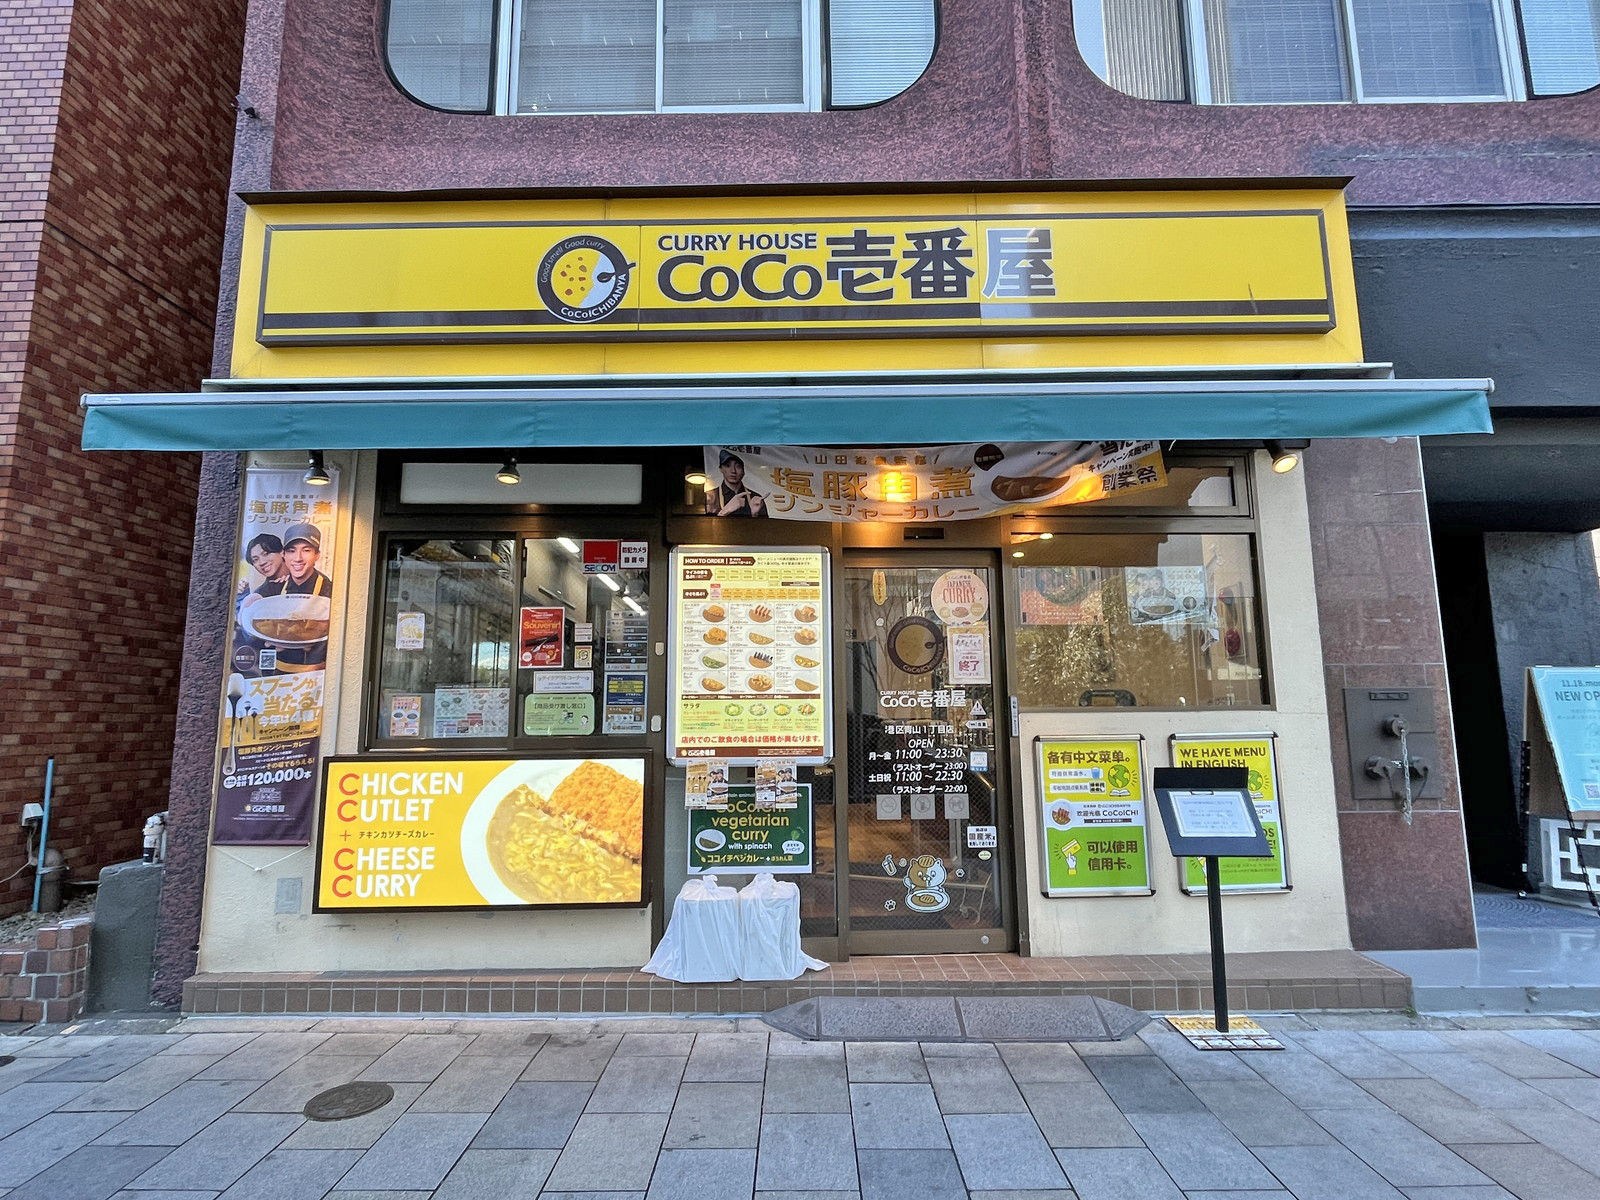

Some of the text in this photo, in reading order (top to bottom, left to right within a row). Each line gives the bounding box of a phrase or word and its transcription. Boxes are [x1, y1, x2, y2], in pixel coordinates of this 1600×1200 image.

[565, 238, 585, 249] Good
[586, 240, 606, 249] curry
[658, 233, 817, 251] CURRY HOUSE
[1102, 465, 1157, 491] 創業祭
[773, 493, 980, 520] ジンジャーカレー
[584, 564, 616, 572] SECOM
[943, 588, 976, 604] CURRY
[958, 660, 980, 672] 終了
[250, 677, 318, 697] スプーンが
[264, 690, 320, 712] 当たる!
[880, 689, 966, 708] CoCo壱番屋
[1555, 691, 1581, 701] NEW
[908, 739, 934, 748] OPEN
[895, 749, 922, 759] 11:00
[934, 748, 963, 759] 23:30
[1048, 750, 1130, 764] 备有中文菜单。
[1180, 747, 1266, 758] WE HAVE MENU
[944, 762, 968, 771] 23:00)
[1181, 759, 1246, 768] IN ENGLISH
[868, 774, 892, 783] 土日祝
[895, 771, 922, 782] 11:00
[934, 771, 963, 781] 22:30
[339, 772, 463, 796] CHICKEN
[944, 785, 968, 793] 22:00)
[337, 799, 434, 822] CUTLET
[711, 814, 789, 830] vegetarian
[358, 829, 435, 840] チキンカツチーズカレー
[732, 830, 769, 843] curry
[728, 842, 773, 850] with spinach
[1087, 841, 1138, 854] 可以使用
[334, 847, 435, 871] CHEESE
[707, 853, 764, 863] ココイチベジカレー
[1088, 858, 1132, 871] 信用卡。
[332, 874, 422, 898] CURRY
